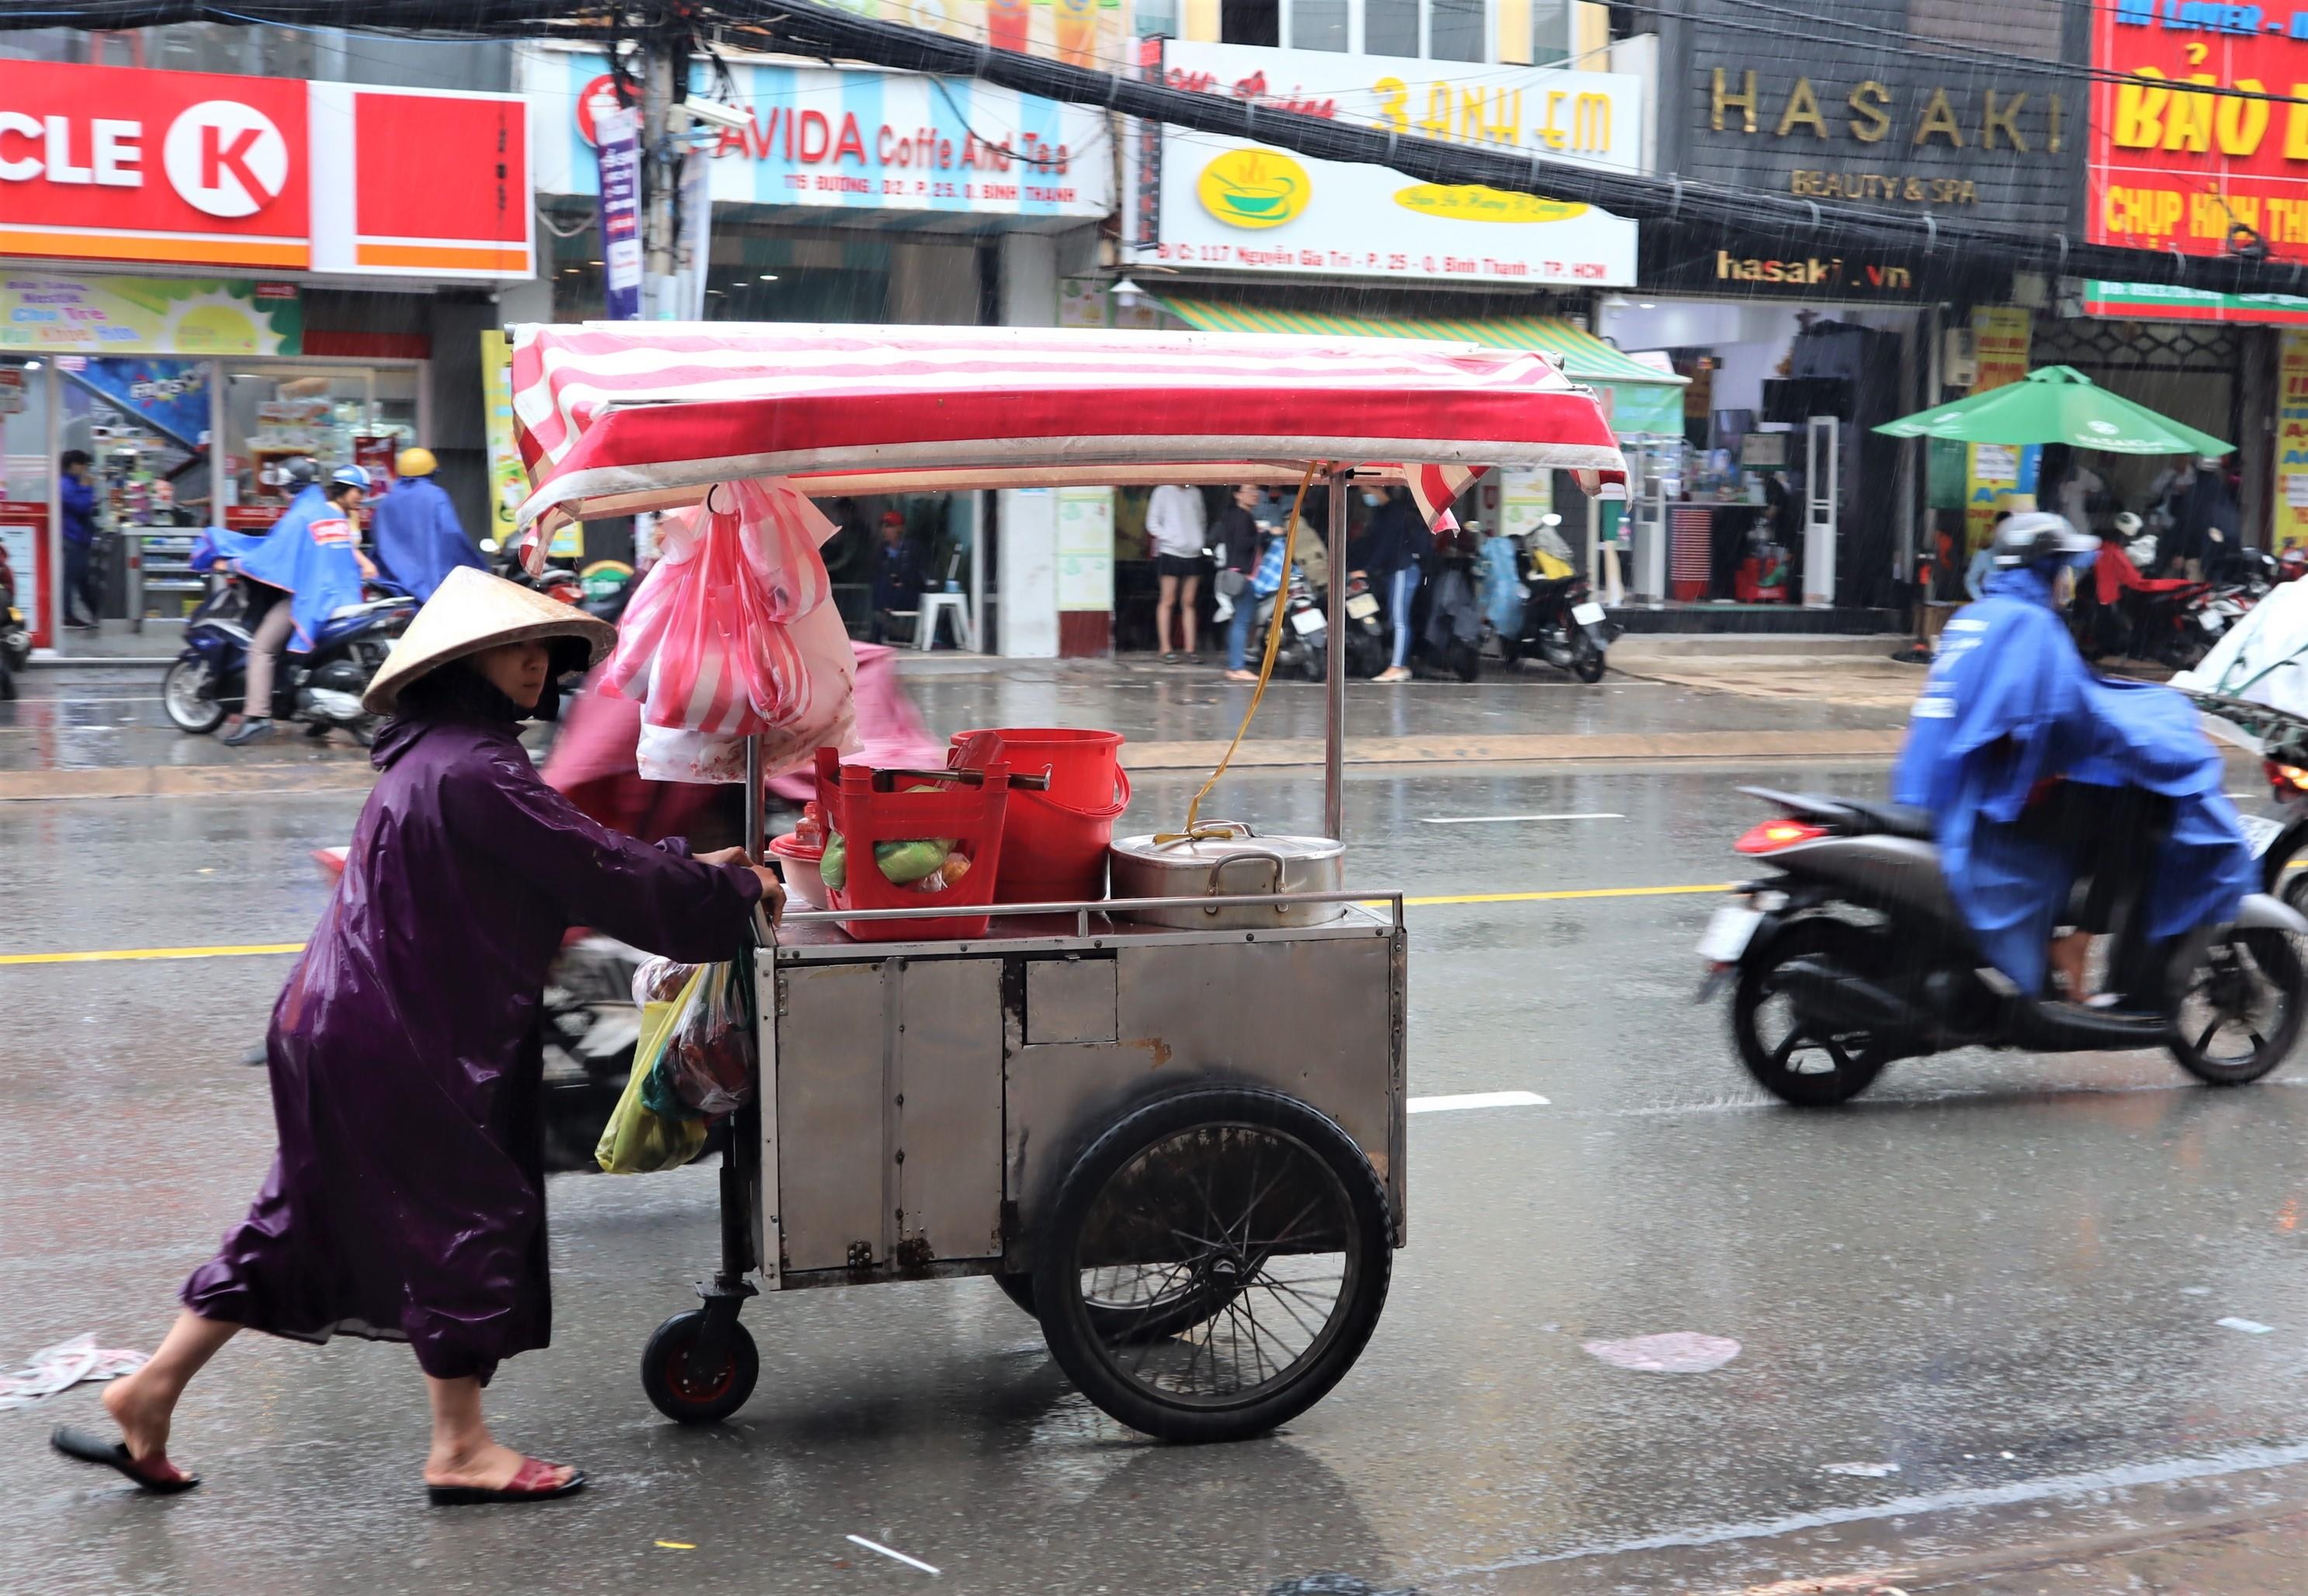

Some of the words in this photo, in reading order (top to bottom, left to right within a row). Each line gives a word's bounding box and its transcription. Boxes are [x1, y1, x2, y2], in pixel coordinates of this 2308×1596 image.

[1371, 76, 1412, 134] 3
[1712, 68, 2062, 154] HASAKI
[2113, 43, 2270, 156] BẢO
[0, 111, 144, 187] CLE
[201, 124, 276, 210] K
[688, 104, 867, 166] AVIDA
[877, 124, 952, 169] Coffe
[959, 130, 1012, 172] And
[1791, 169, 1900, 200] BEAUTY
[1903, 177, 1925, 201] &
[1930, 178, 1978, 204] SPA
[2105, 185, 2185, 249] CHỤP
[1201, 244, 1230, 261] 117
[1387, 254, 1408, 270] 25
